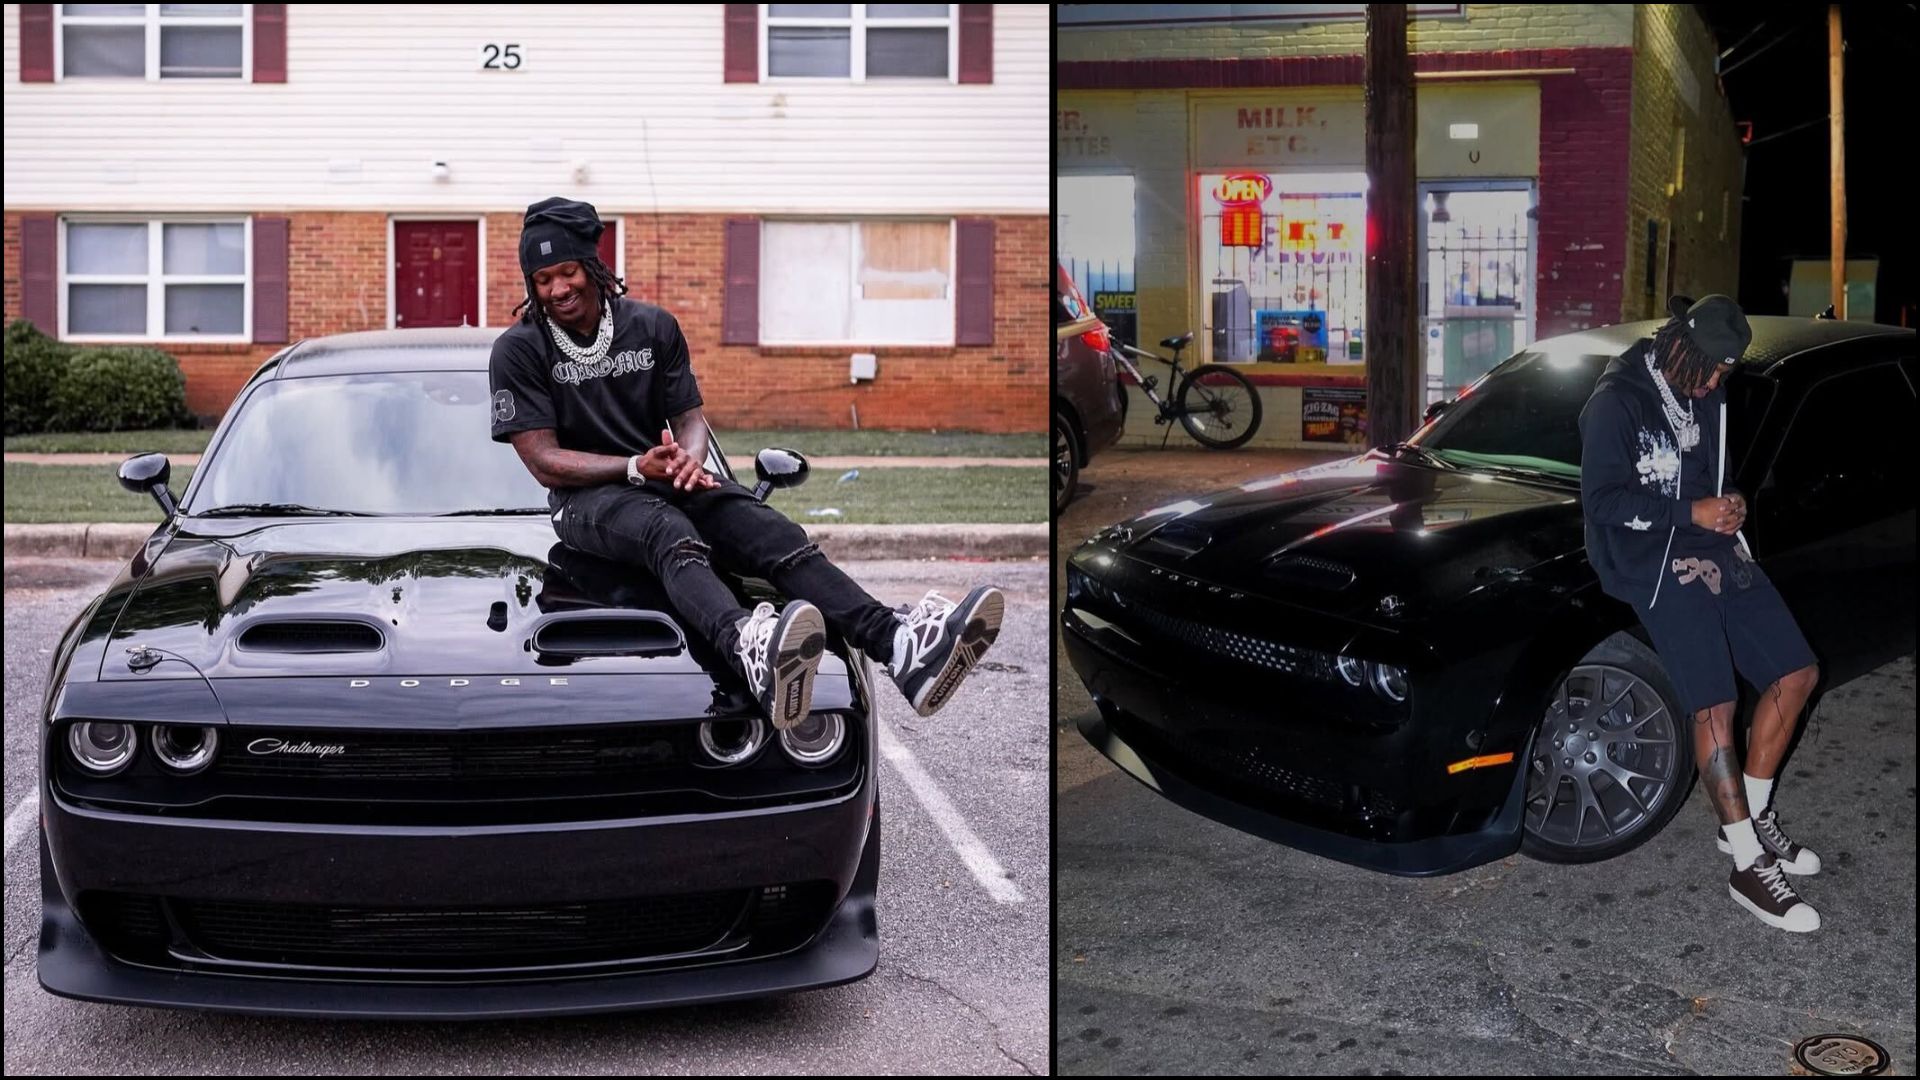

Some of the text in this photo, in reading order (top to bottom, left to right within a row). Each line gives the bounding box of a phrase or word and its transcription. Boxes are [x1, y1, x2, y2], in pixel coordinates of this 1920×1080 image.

[483, 44, 522, 69] 25
[1057, 136, 1111, 155] TTES
[1220, 179, 1265, 200] OPEN
[552, 347, 655, 386] CHROME
[350, 678, 569, 688] DODGE
[931, 658, 966, 704] VUITTON
[788, 679, 801, 719] VUITTON
[247, 737, 346, 759] Challenger
